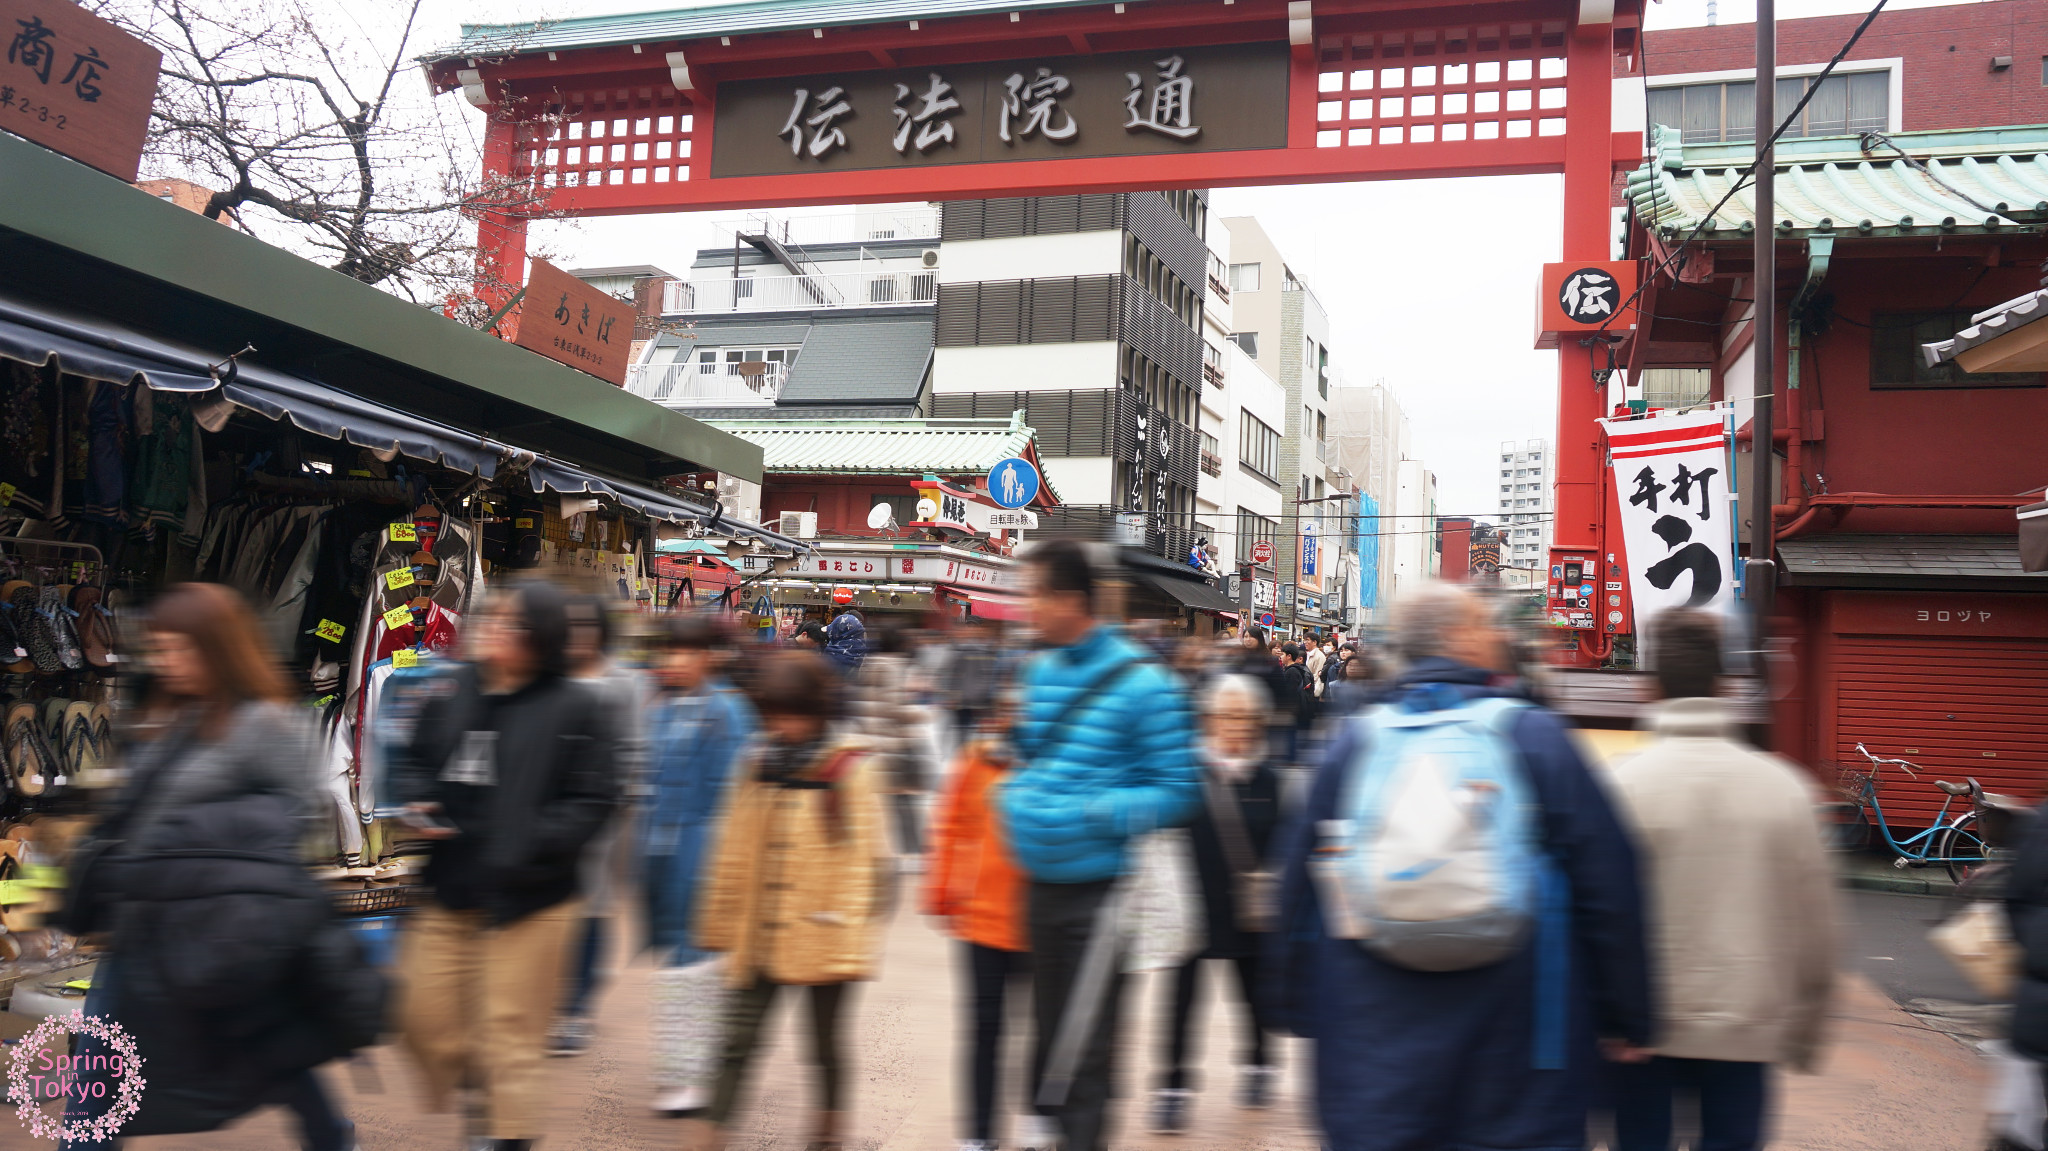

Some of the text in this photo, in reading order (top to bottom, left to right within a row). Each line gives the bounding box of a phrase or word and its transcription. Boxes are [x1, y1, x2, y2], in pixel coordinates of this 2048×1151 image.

[8, 15, 110, 103] 商店
[779, 54, 1203, 159] 伝法院通
[554, 291, 617, 345] あきば
[1562, 272, 1611, 316] 伝
[1629, 463, 1718, 521] 手打
[990, 513, 1034, 526] 自転車を除く
[1254, 549, 1271, 558] 消火栓
